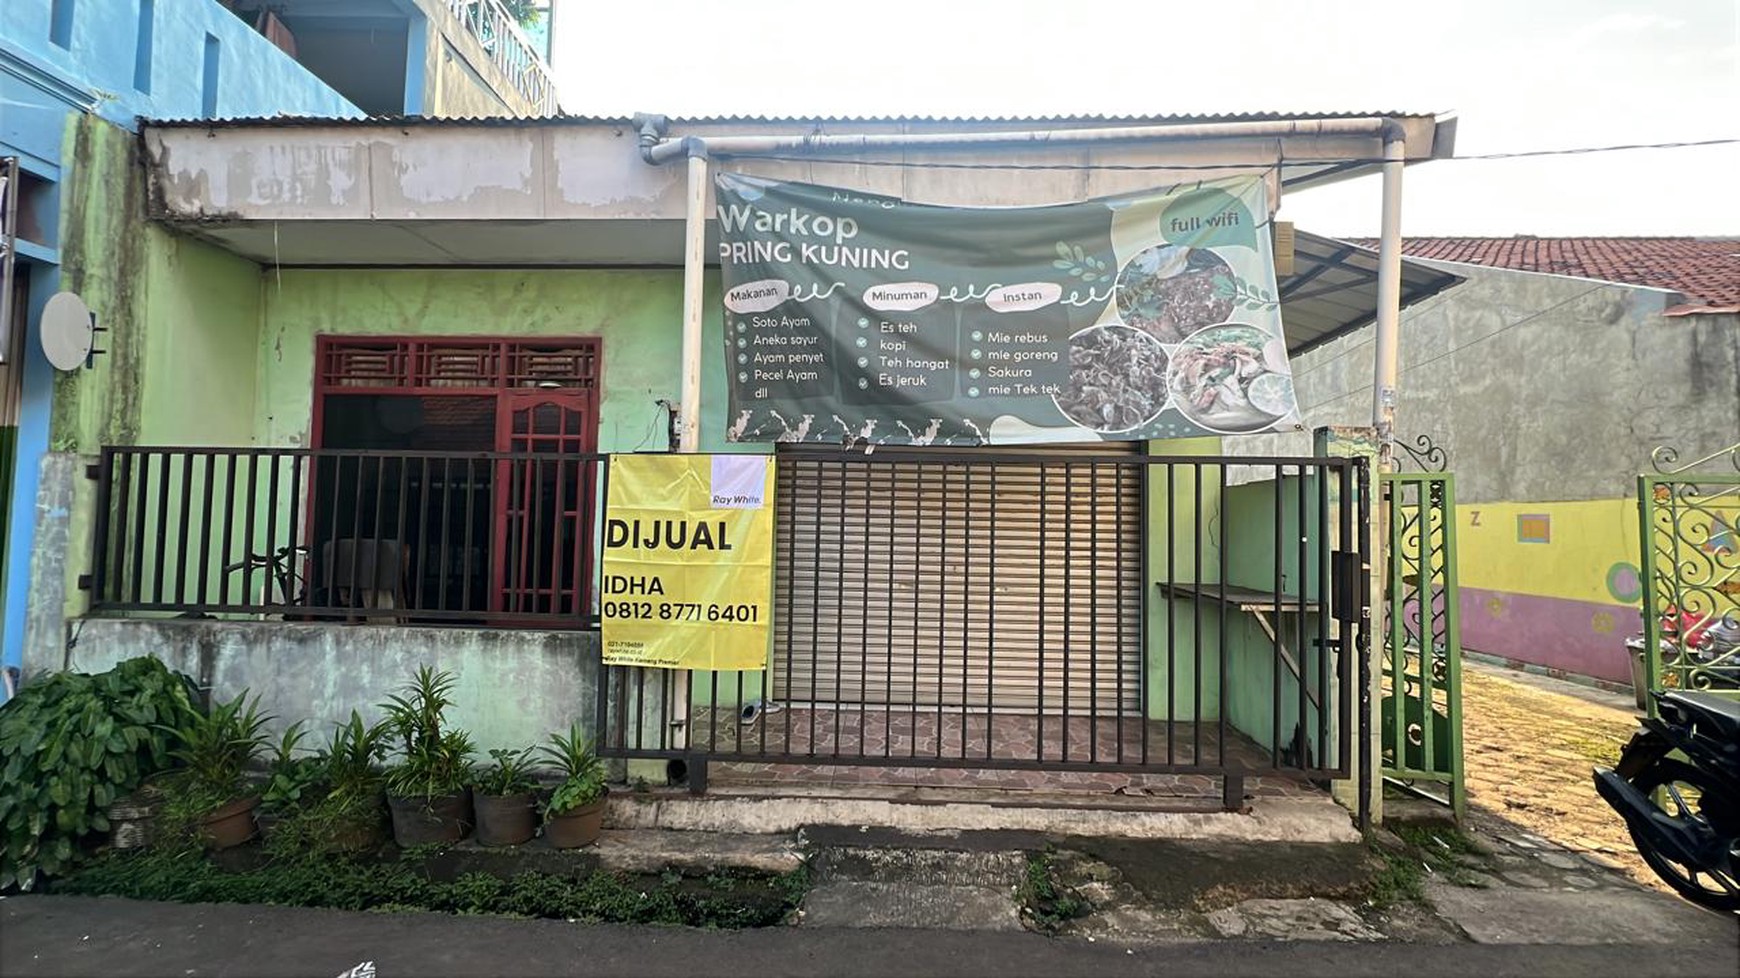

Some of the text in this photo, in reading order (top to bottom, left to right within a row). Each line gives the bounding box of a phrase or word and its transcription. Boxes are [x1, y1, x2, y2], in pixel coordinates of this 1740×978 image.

[717, 204, 859, 244] Warkop
[1170, 212, 1240, 233] full wifi
[719, 241, 909, 270] PRING KUNING
[730, 287, 778, 301] Makanan
[872, 290, 928, 301] Minuman
[1003, 291, 1042, 302] Instan
[752, 316, 810, 330] Soto Ayam
[880, 322, 917, 333] Es teh
[753, 334, 818, 348] Aneka sayur
[987, 331, 1048, 343] Mie rebus
[880, 340, 906, 352] kopi
[753, 352, 824, 367] Ayam penyet
[987, 349, 1059, 363] mie goreng
[879, 356, 949, 372] Teh hangat
[754, 370, 818, 382] Pecel Ayam
[987, 366, 1032, 378] Sakura
[879, 374, 927, 388] Es jeruk
[754, 387, 768, 399] dll
[988, 383, 1062, 395] mie Tek tek
[712, 494, 732, 505] Ray
[1470, 511, 1481, 527] Z
[606, 519, 732, 551] DIJUAL
[604, 574, 665, 595] IDHA
[604, 601, 757, 623] 0812 8771 6401
